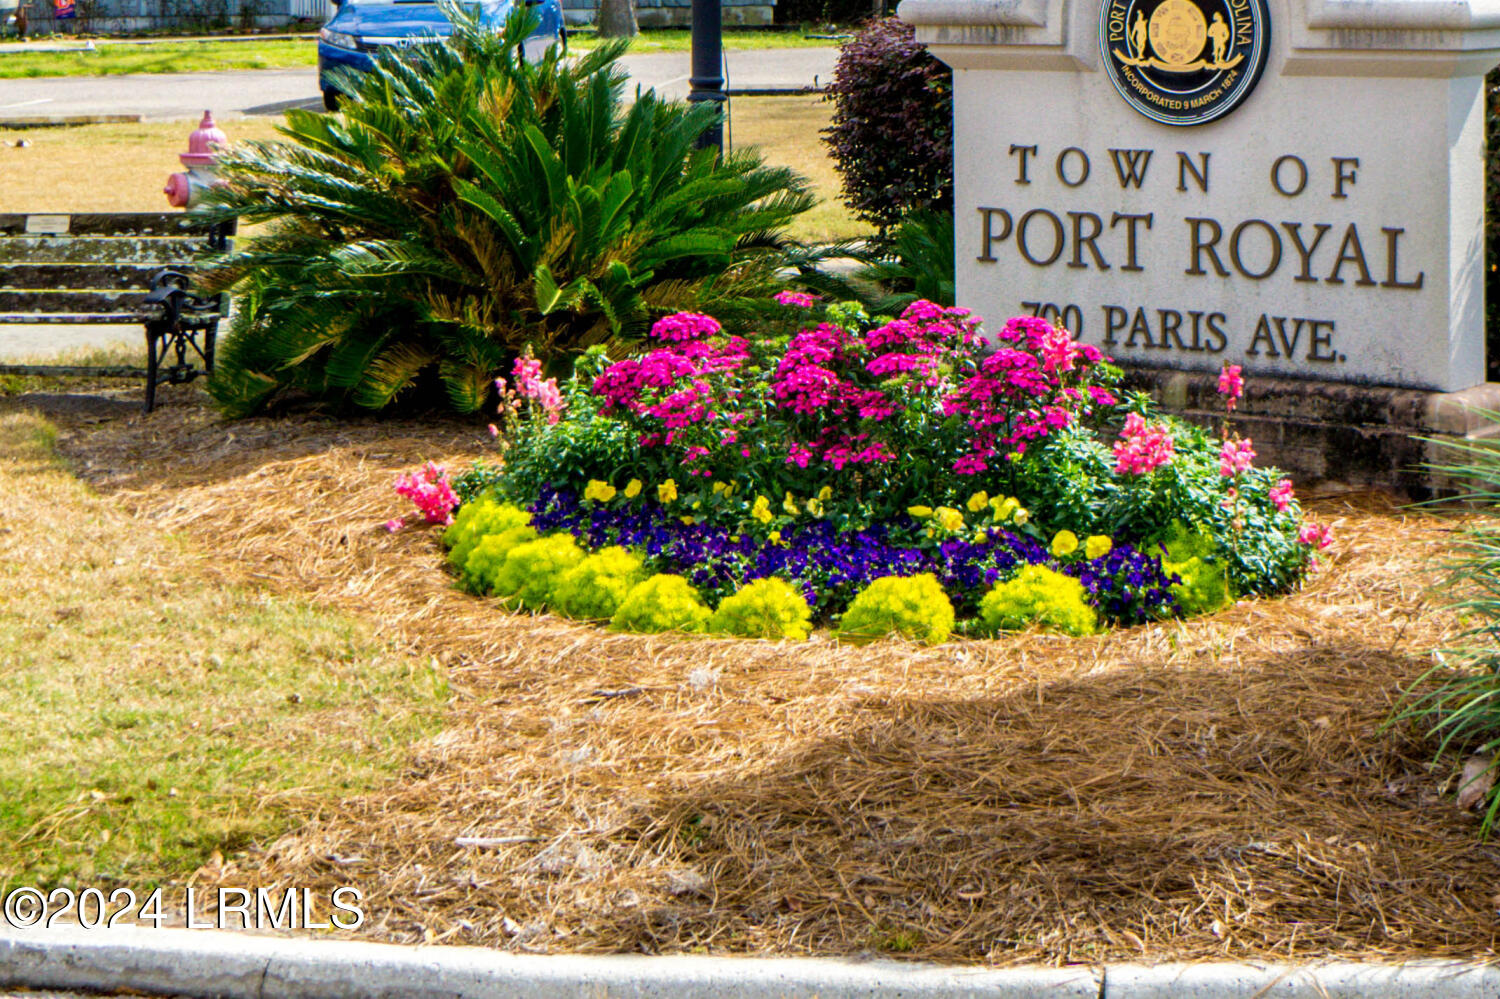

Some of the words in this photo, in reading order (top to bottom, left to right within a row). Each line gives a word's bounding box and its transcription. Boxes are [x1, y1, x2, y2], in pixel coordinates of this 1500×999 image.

[1109, 0, 1126, 42] PORT
[1121, 65, 1182, 110] INCORPORATED
[1183, 100, 1190, 110] 9
[1191, 88, 1222, 109] MARCH
[1221, 70, 1239, 91] 1874
[1008, 143, 1211, 193] TOWN
[1270, 154, 1360, 199] OF
[976, 206, 1154, 272] PORT
[1184, 216, 1425, 291] ROYAL
[1101, 304, 1229, 354] PARIS
[1246, 313, 1347, 364] AVE.
